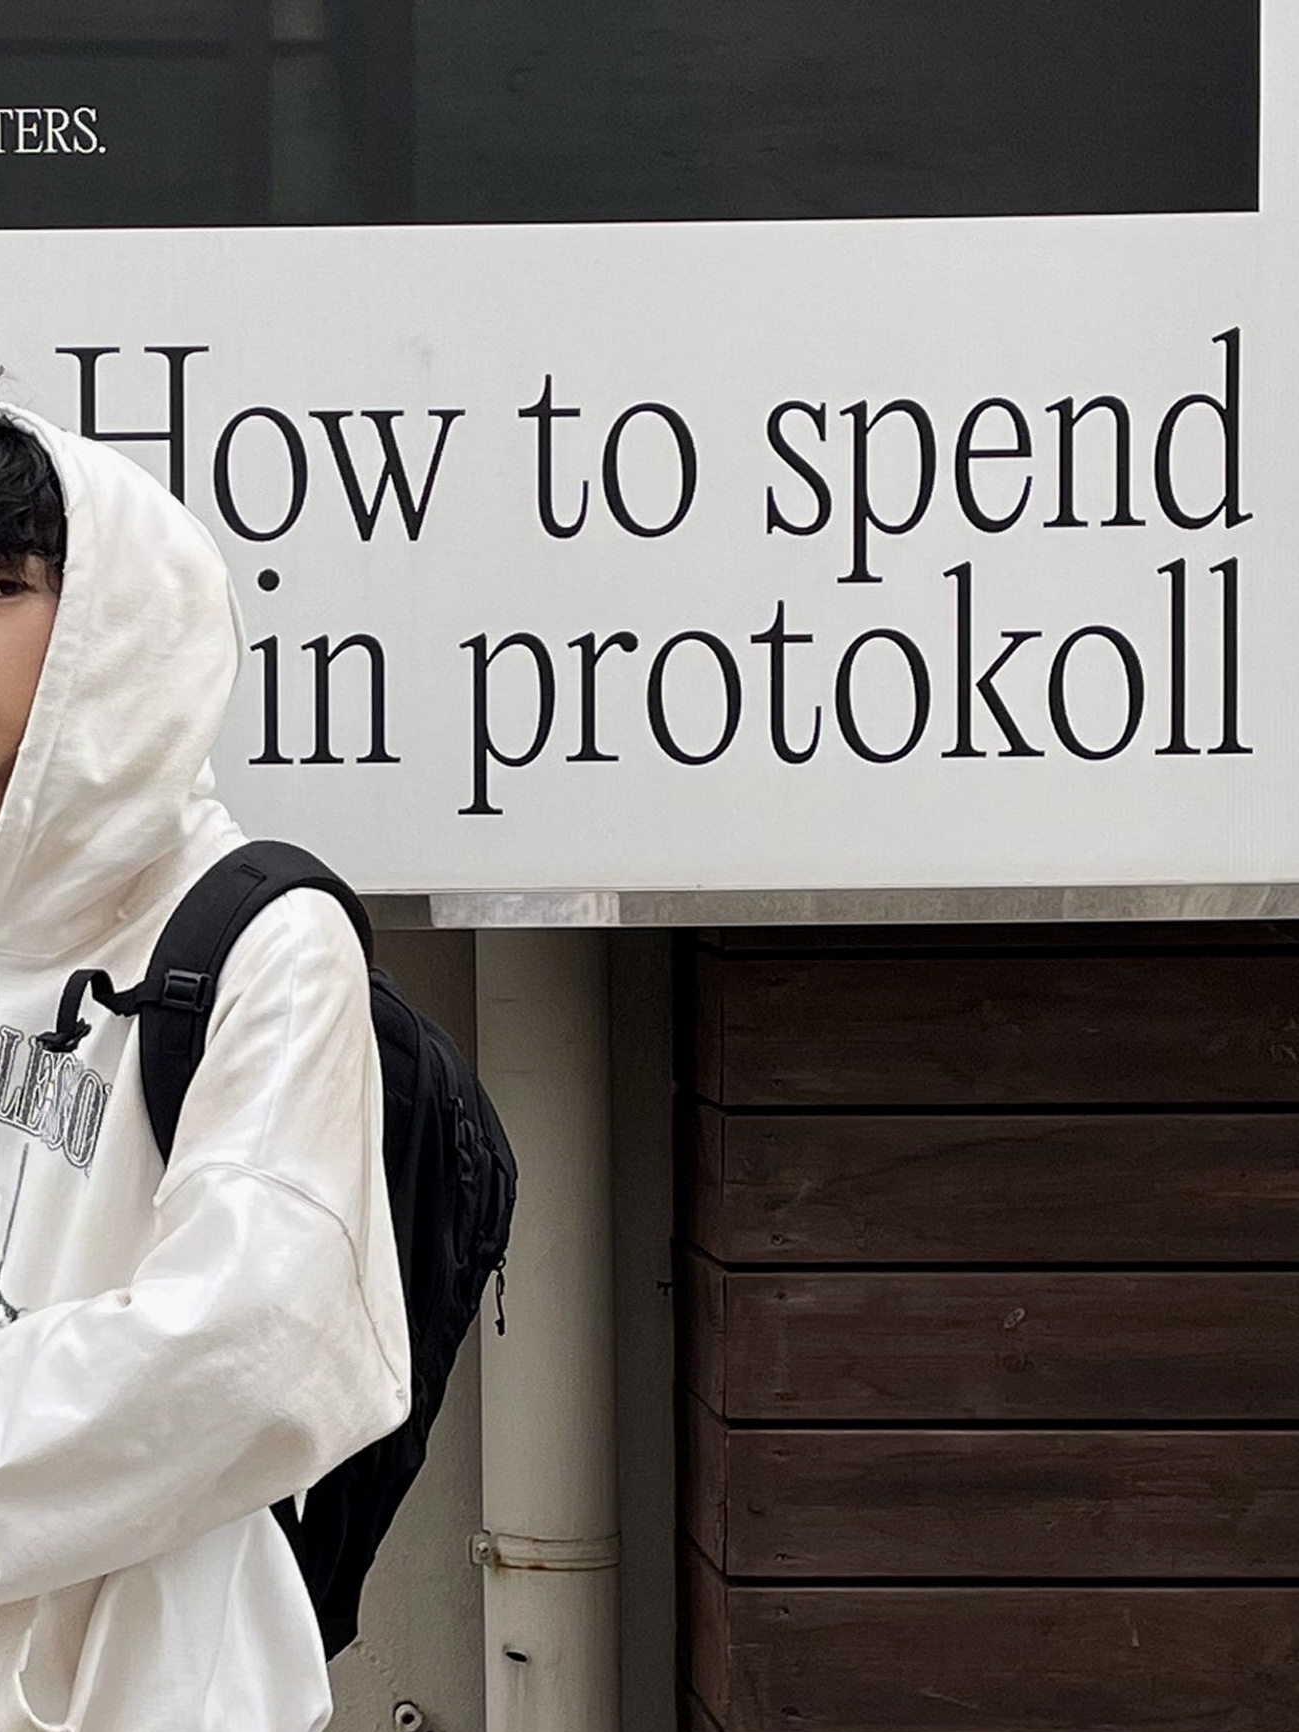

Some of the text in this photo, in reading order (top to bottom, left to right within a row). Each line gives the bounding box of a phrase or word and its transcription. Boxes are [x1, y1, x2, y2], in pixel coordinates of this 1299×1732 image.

[55, 326, 1254, 584] How to spend
[248, 569, 401, 765] in
[457, 557, 1254, 816] protokoll
